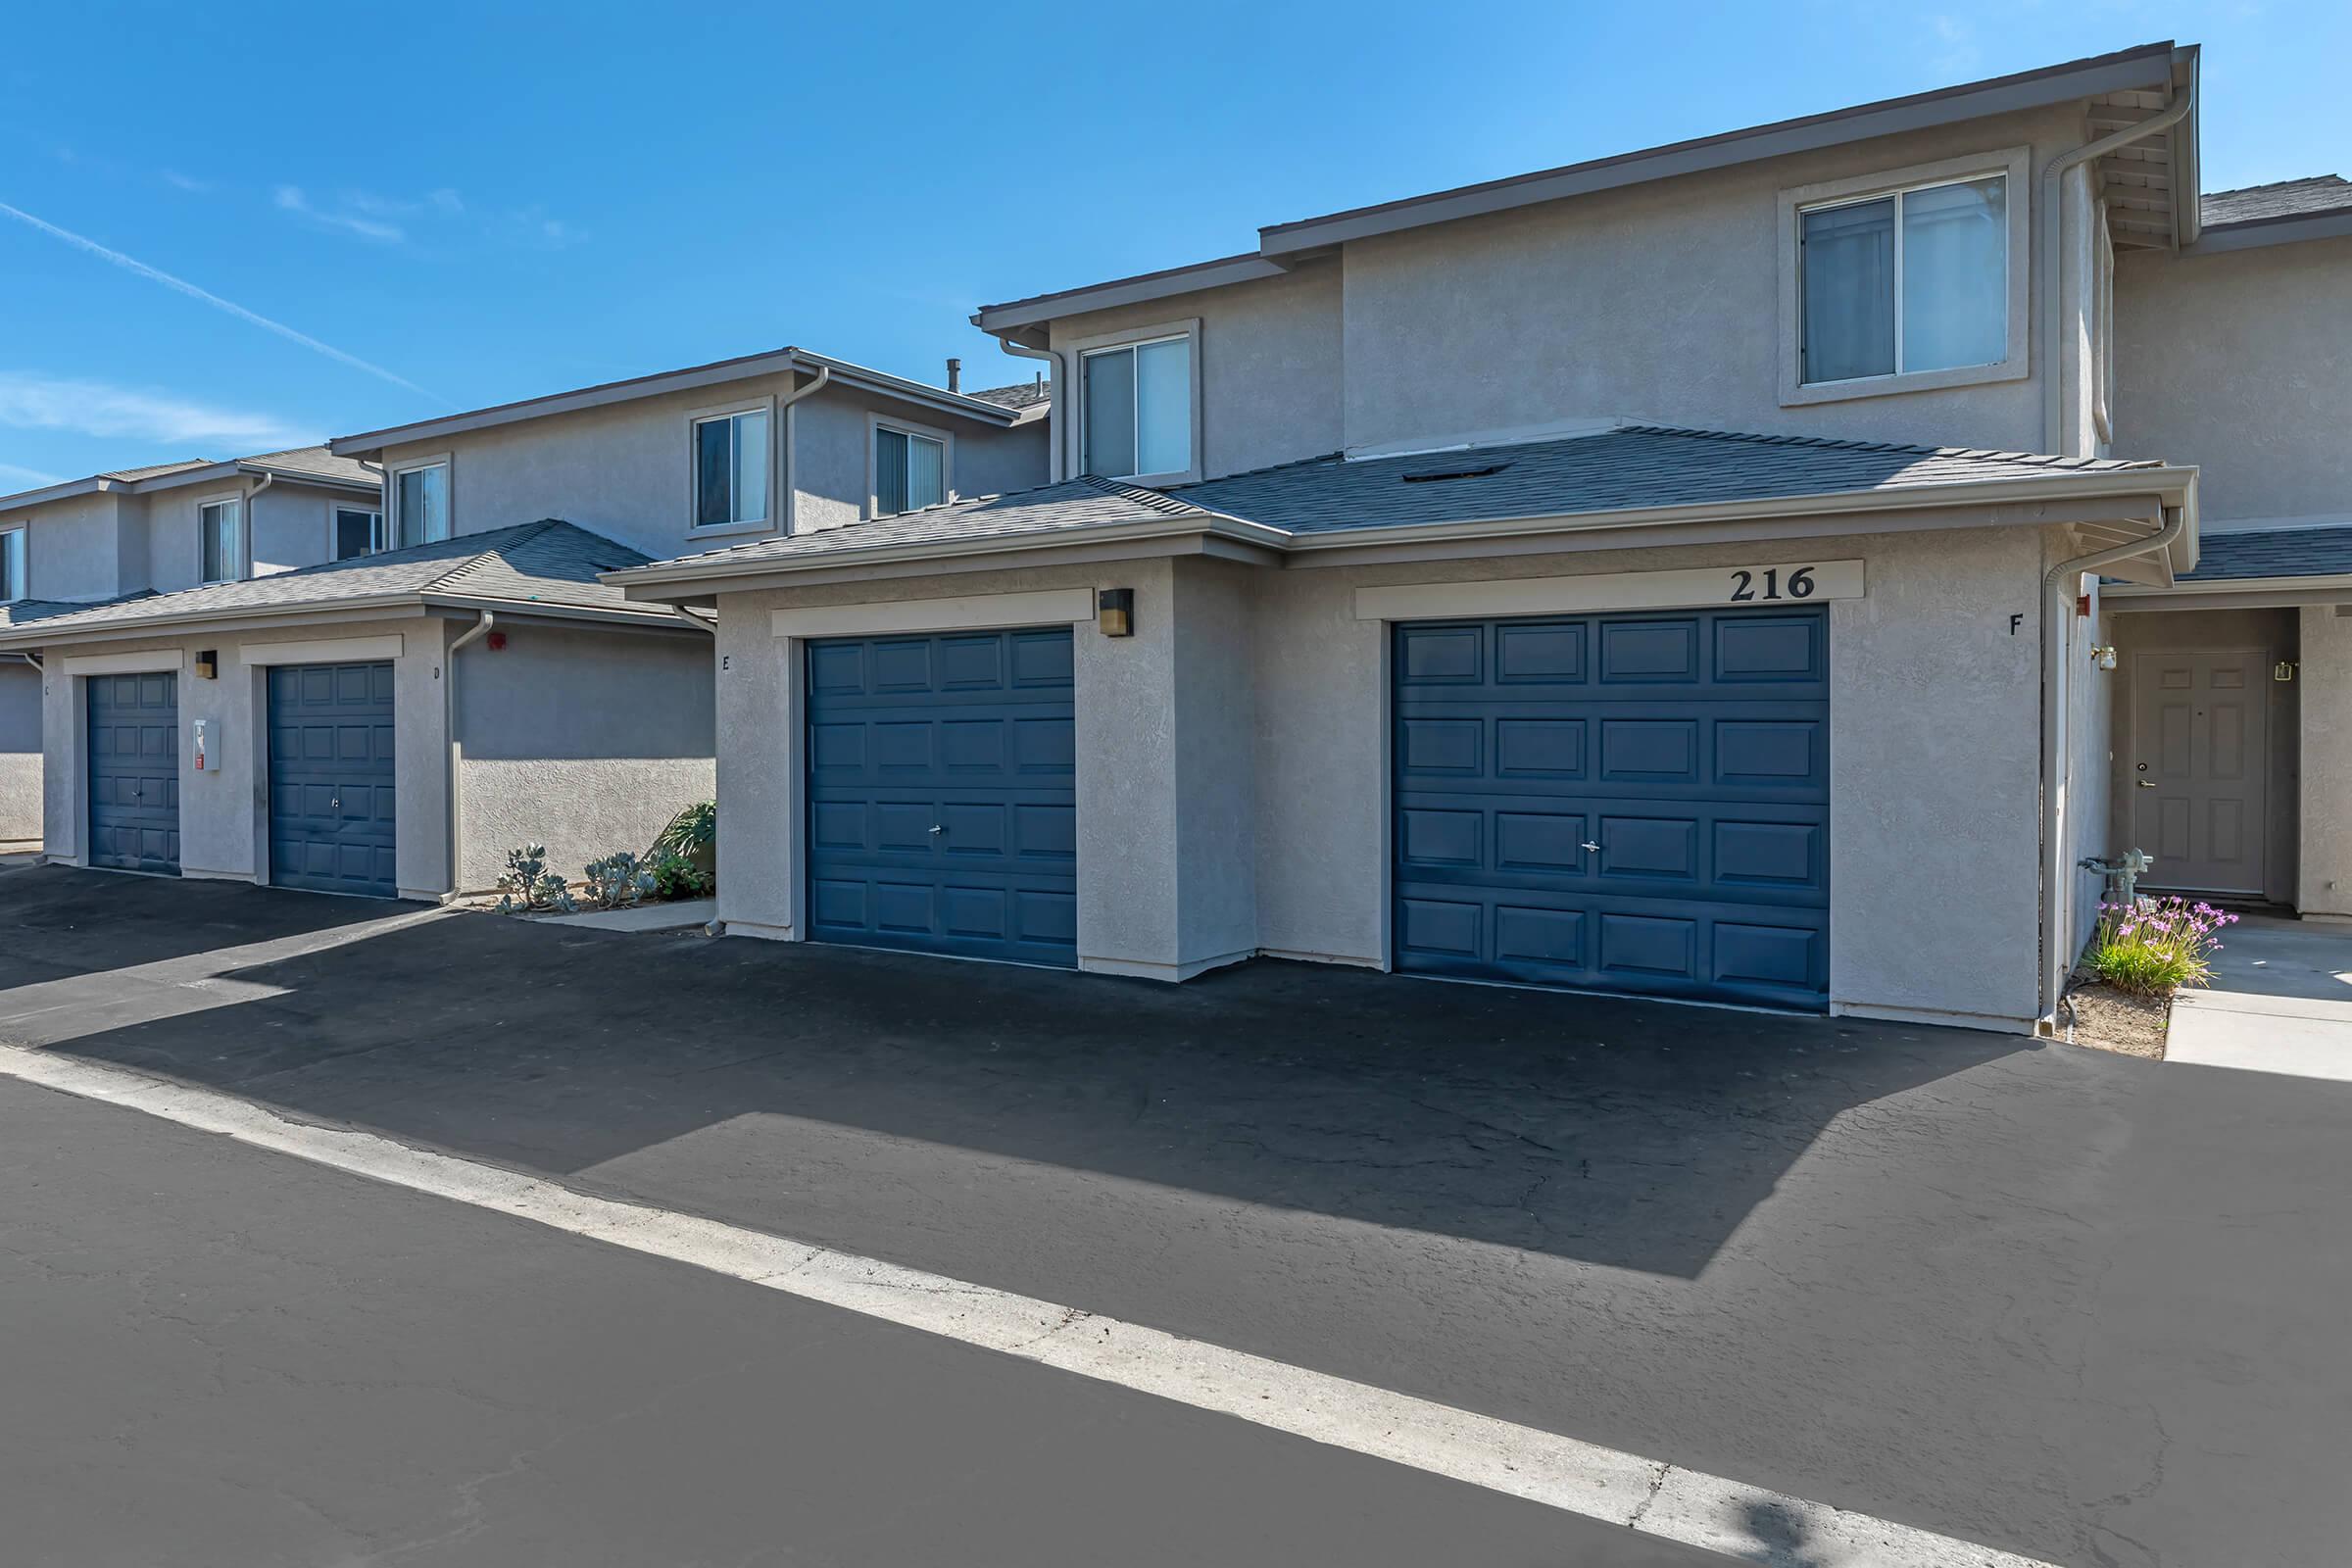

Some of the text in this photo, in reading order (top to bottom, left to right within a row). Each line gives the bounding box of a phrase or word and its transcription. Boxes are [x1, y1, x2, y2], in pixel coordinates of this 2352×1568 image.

[1731, 566, 1815, 602] 216
[2010, 613, 2024, 635] F
[722, 656, 729, 670] E
